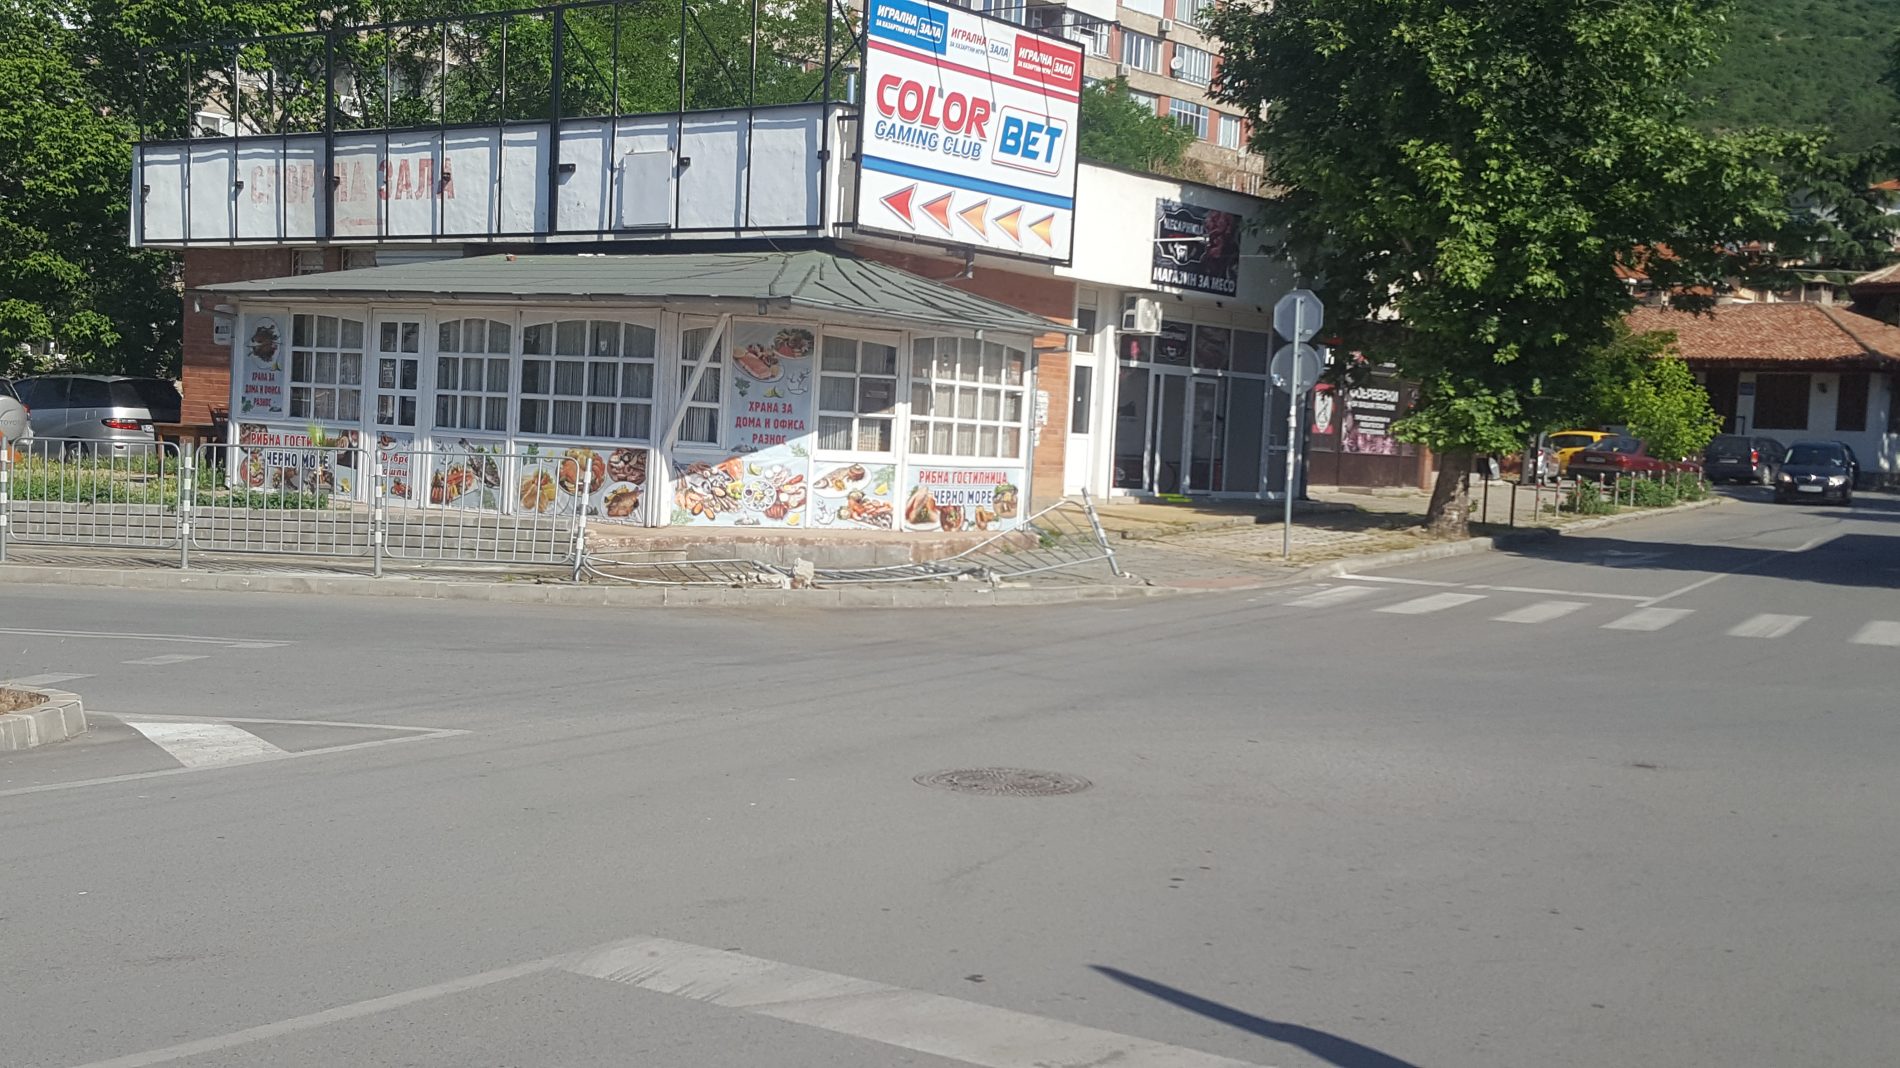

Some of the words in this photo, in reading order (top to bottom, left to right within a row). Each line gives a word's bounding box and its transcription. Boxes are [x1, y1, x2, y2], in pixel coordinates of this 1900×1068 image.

[877, 5, 917, 26] ИГРАЛНА
[919, 23, 942, 39] ЗАЛА
[951, 27, 987, 45] ИГРАЛНА
[989, 43, 1009, 58] ЗАЛА
[1018, 47, 1053, 66] ИГРАЛНА
[1054, 62, 1073, 76] ЗАЛА
[876, 73, 991, 141] COLOR
[875, 120, 939, 149] GAMING
[943, 136, 983, 159] CLUB
[998, 115, 1063, 163] BET
[377, 157, 455, 201] ЗАЛА
[1153, 267, 1198, 287] МАГАЗИН
[1198, 274, 1210, 289] ЗА
[1211, 277, 1236, 293] МЕСО
[748, 401, 779, 414] ХРАНА
[781, 403, 793, 414] ЗА
[735, 416, 761, 428] ДОМА
[764, 418, 771, 429] И
[774, 419, 805, 431] ОФИСА
[251, 432, 281, 447] РИБНА
[752, 433, 787, 445] РАЗНОС
[267, 451, 297, 467] ЧЕРНО
[919, 470, 949, 484] РИБНА
[952, 471, 1009, 485] ГОСТИЛНИЦА
[934, 490, 964, 504] ЧЕРНО
[967, 490, 993, 505] МОРЕ
